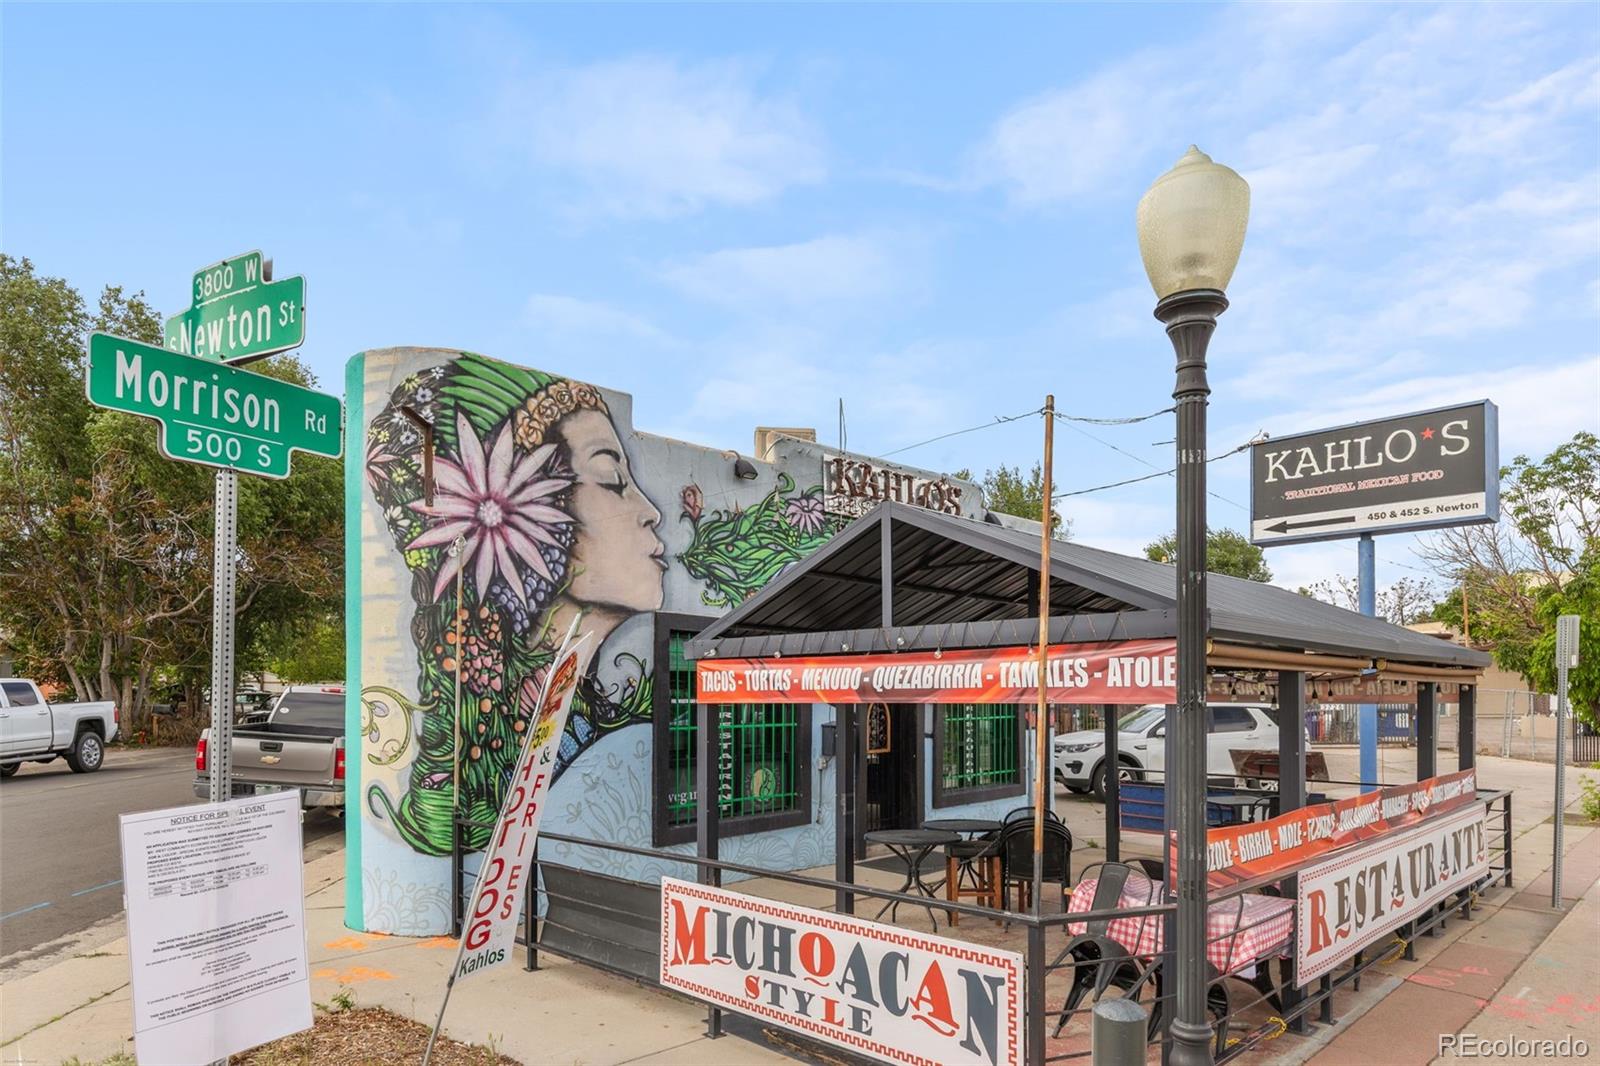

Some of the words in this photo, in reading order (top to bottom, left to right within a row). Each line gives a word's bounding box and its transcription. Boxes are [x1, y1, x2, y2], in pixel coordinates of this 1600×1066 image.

[195, 265, 234, 300] 3800
[245, 257, 258, 282] W
[180, 304, 272, 356] Newton
[279, 300, 295, 327] St
[115, 350, 280, 433] Morrison
[304, 410, 327, 435] Rd
[187, 429, 241, 461] 500
[257, 445, 272, 467] S
[1411, 469, 1445, 483] FOOD
[1367, 511, 1387, 521] 450
[1389, 510, 1398, 519] &
[1400, 507, 1420, 517] 452
[1435, 500, 1480, 515] Newton
[701, 669, 737, 692] TACOS
[744, 668, 793, 691] TORTAS
[801, 666, 863, 691] MENUDO
[872, 662, 983, 693] QUEZABIRRIA
[1107, 655, 1177, 688] ATOLE
[540, 745, 552, 766] &
[170, 814, 198, 826] NOTICE
[199, 811, 216, 822] FOR
[1238, 829, 1273, 864] BIRRIA
[1278, 821, 1303, 852] MOLE
[1306, 820, 1485, 957] RESTAURANTE
[459, 947, 506, 978] Kahlos
[670, 898, 1006, 1066] MICHOACAN
[744, 974, 874, 1037] STYLE
